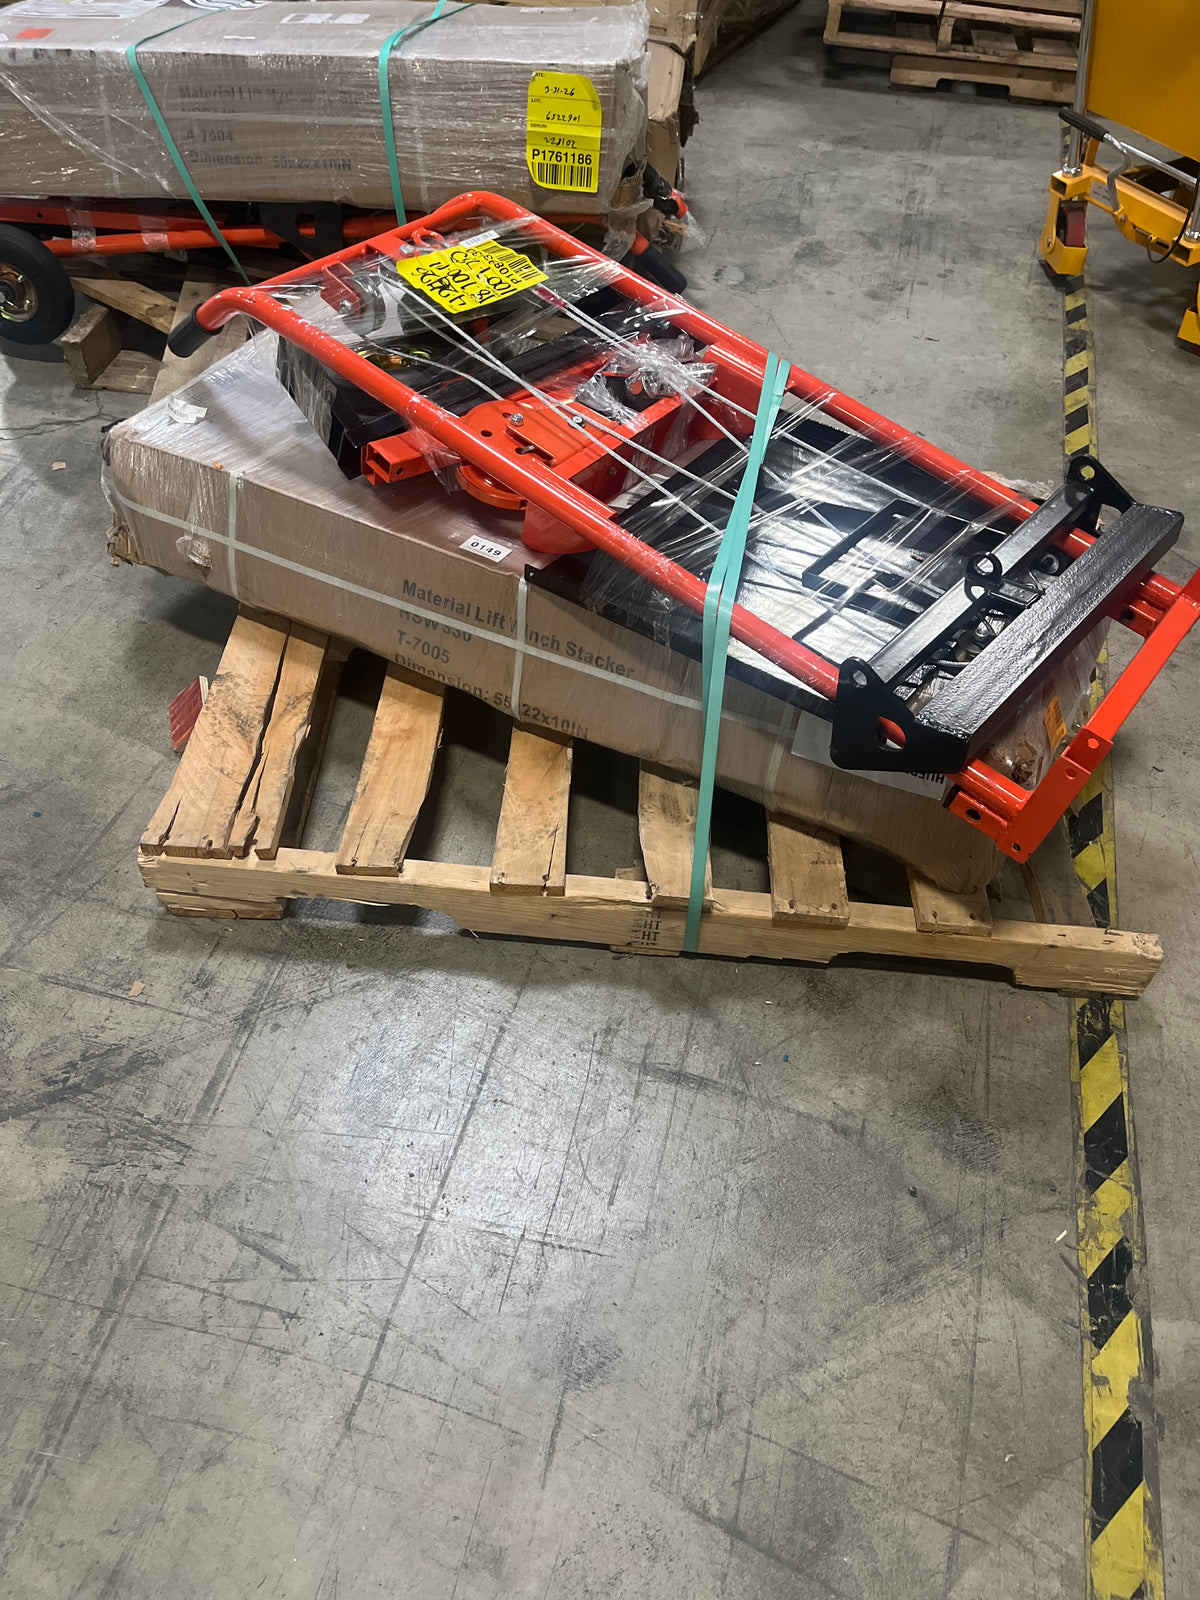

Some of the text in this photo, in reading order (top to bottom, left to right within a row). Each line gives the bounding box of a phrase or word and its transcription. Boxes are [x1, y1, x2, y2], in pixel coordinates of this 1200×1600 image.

[532, 148, 592, 165] P1761186
[470, 541, 502, 556] 0149
[402, 579, 472, 618] Material
[475, 606, 506, 630] Lift
[565, 640, 635, 679] Stacker
[396, 629, 451, 665] T-7005
[641, 931, 660, 941] HT
